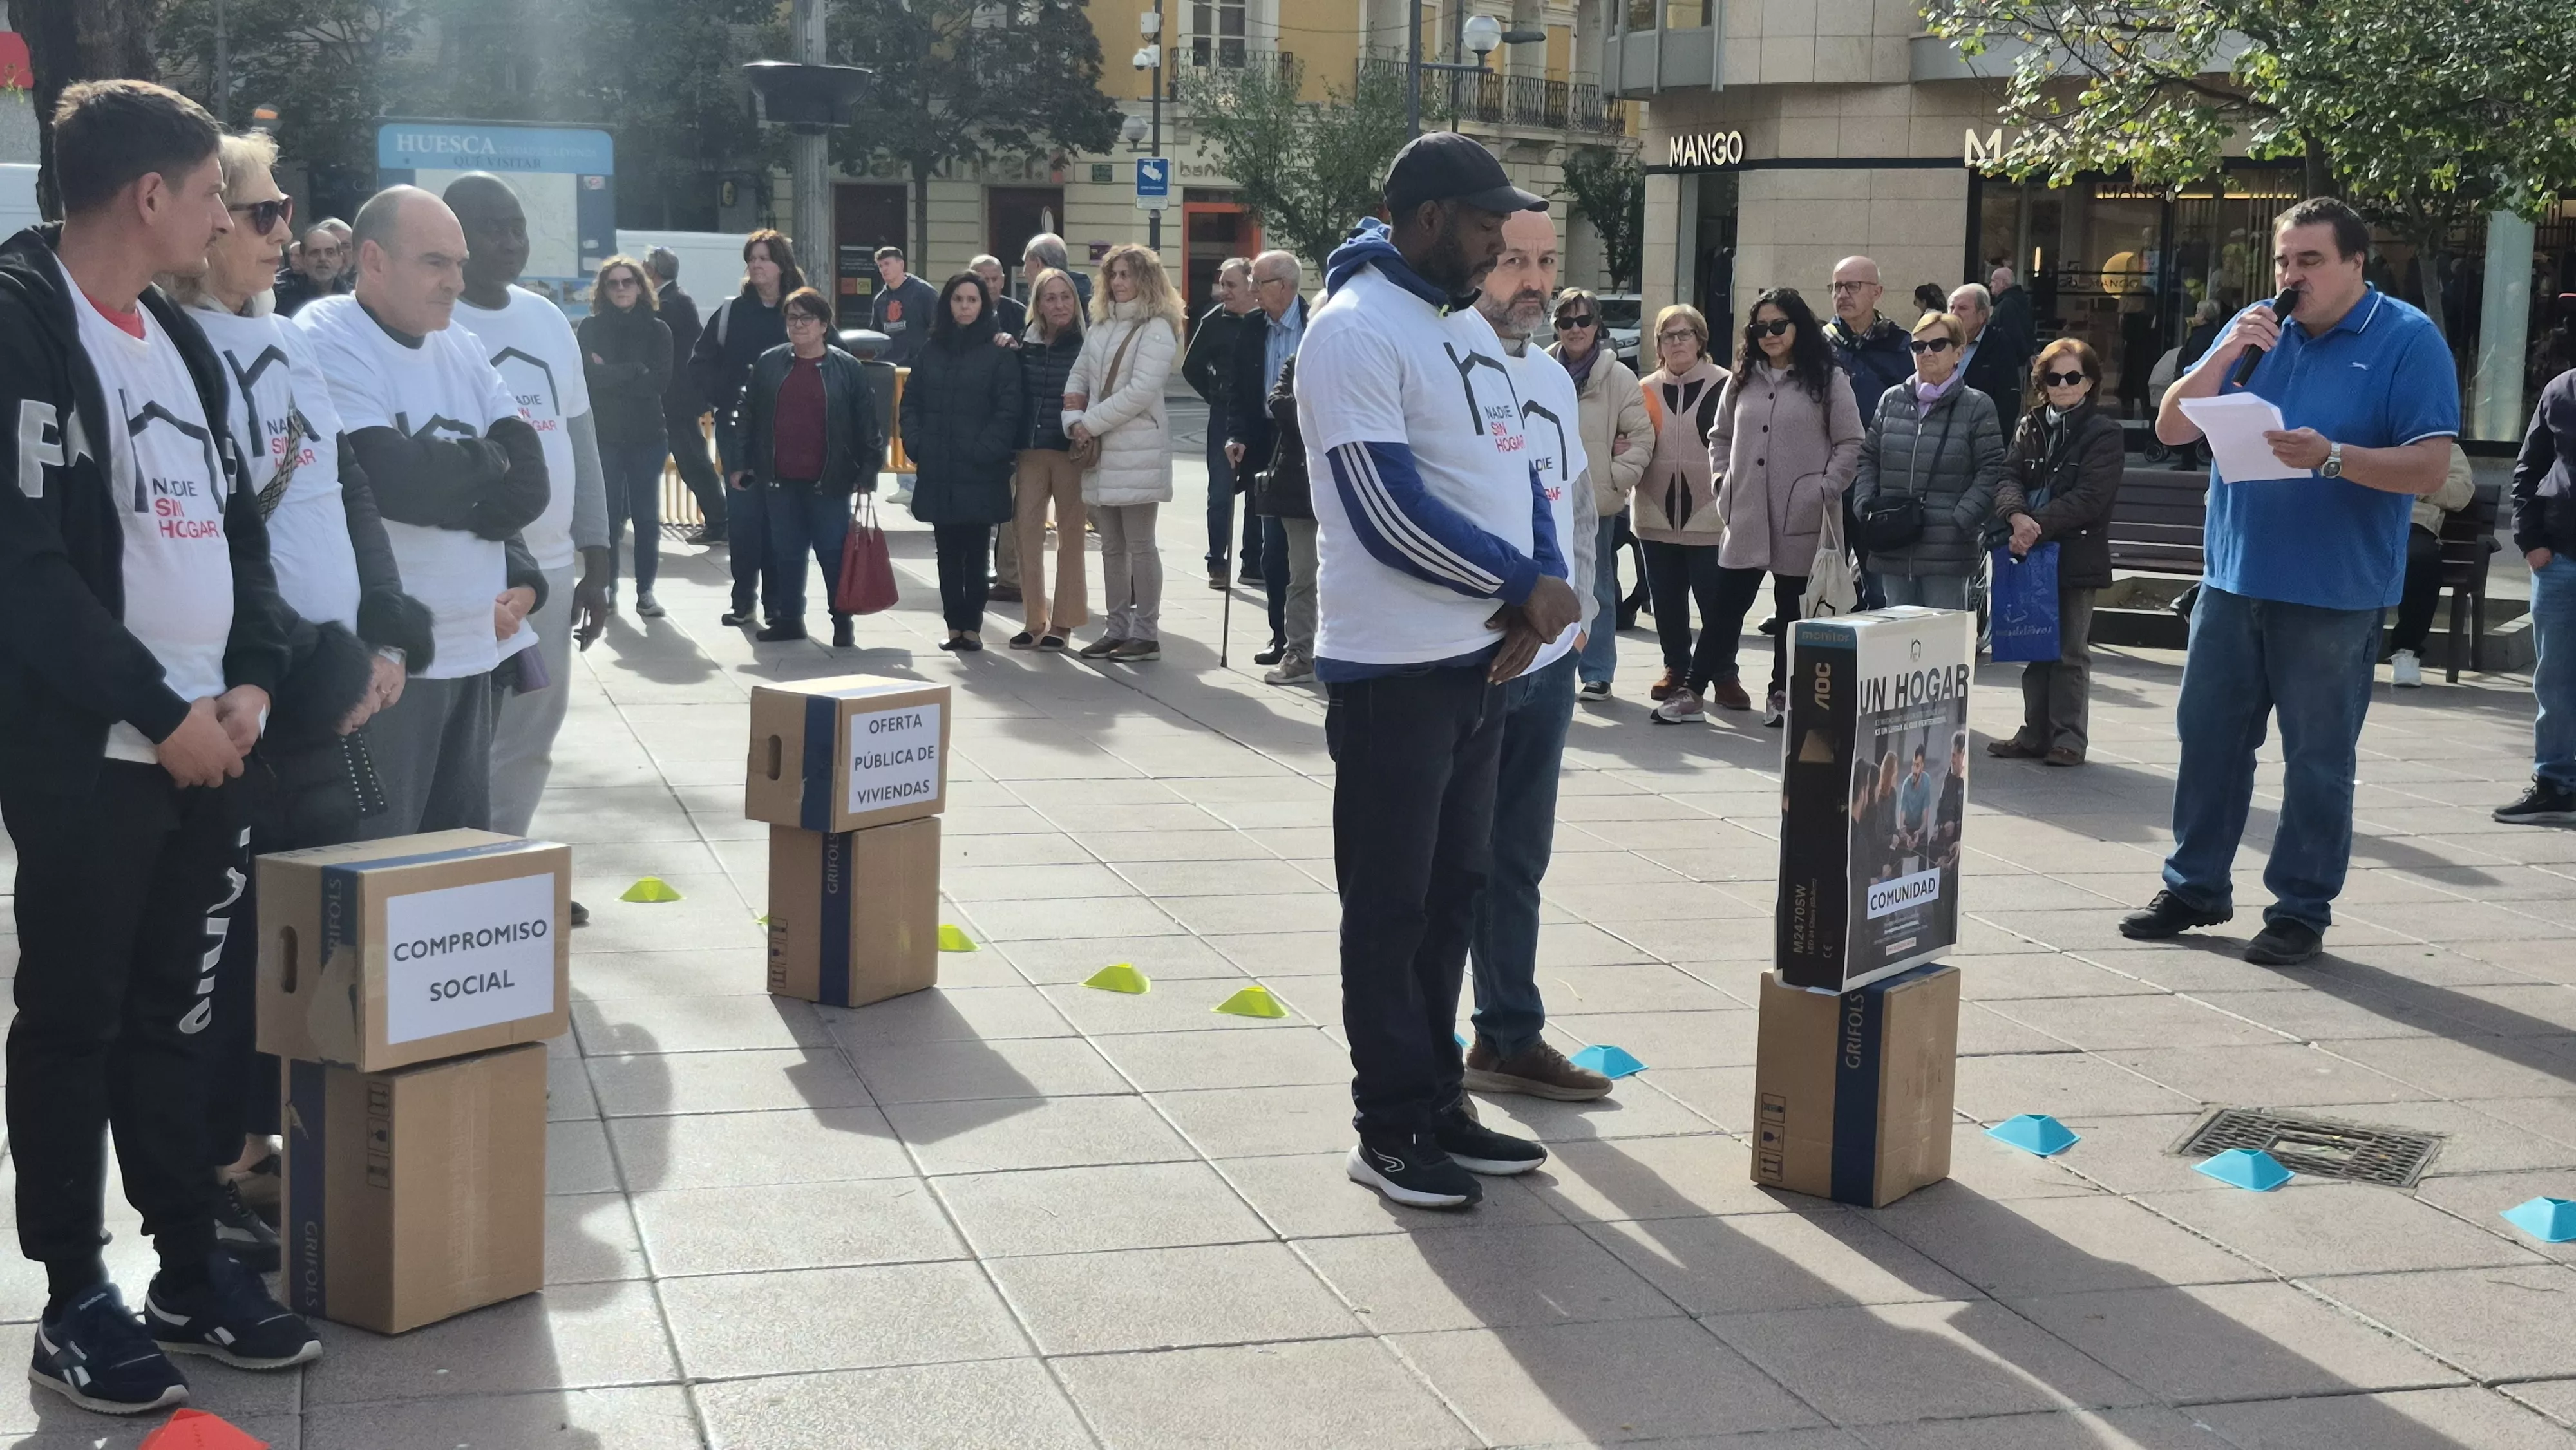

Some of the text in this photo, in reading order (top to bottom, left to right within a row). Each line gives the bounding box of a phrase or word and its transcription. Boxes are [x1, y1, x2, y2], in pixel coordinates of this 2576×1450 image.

[396, 133, 497, 155] HUESCA
[1669, 130, 1744, 167] MANGO
[487, 156, 542, 169] VISITAR
[515, 394, 542, 406] ADIE
[1484, 405, 1513, 419] NADIE
[532, 420, 557, 431] GAR
[1491, 421, 1507, 436] SIN
[274, 449, 317, 469] HAR
[1535, 457, 1553, 471] DIE
[158, 520, 220, 539] HOGAR
[1801, 630, 1851, 643] monitor
[1859, 663, 1970, 716] UN HOGAR
[869, 714, 923, 735] OFERTA
[854, 745, 935, 771] PÚBLICA DE
[857, 779, 930, 804] VIVIENDAS
[828, 833, 839, 894] GRIFOLS
[1870, 876, 1937, 912] COMUNIDAD
[327, 878, 341, 952] RIFOLS
[1794, 883, 1806, 954] M2470SW
[393, 918, 549, 963] COMPROMISO
[429, 968, 516, 1003] SOCIAL
[1845, 993, 1865, 1069] GRIFOLS
[305, 1220, 318, 1308] GRIFOLS
